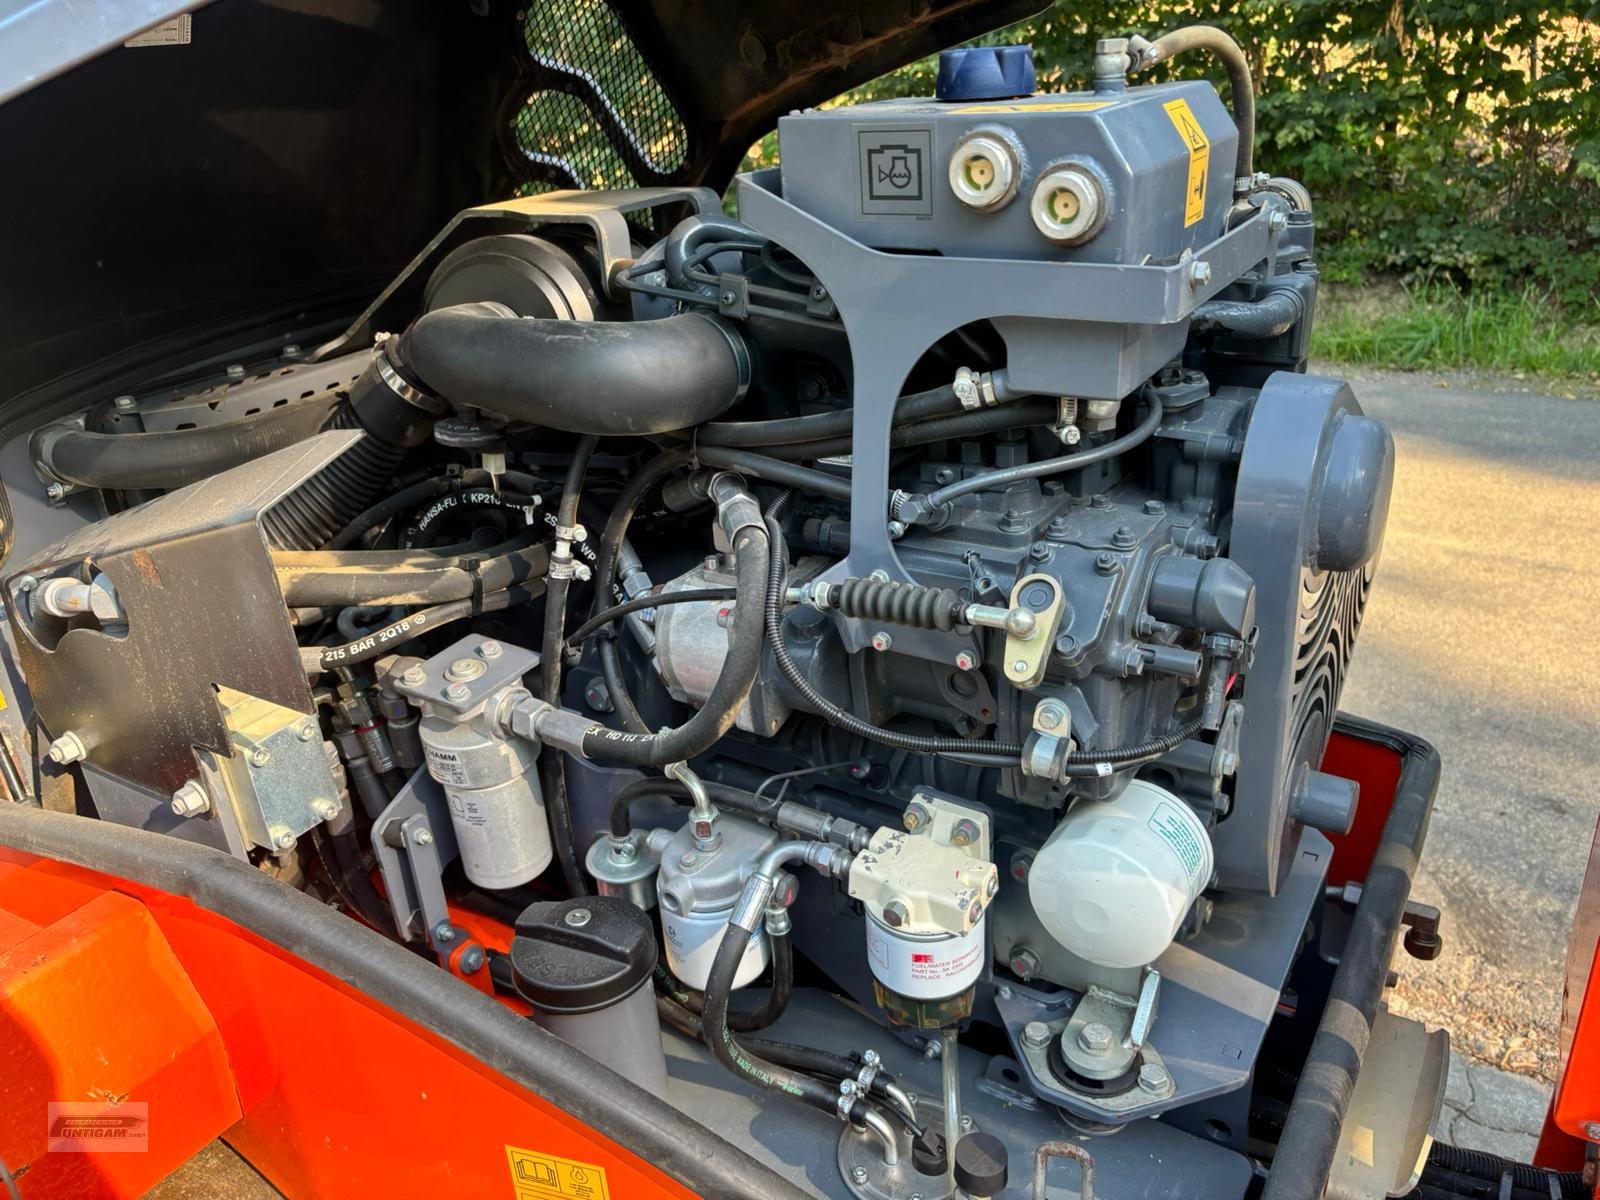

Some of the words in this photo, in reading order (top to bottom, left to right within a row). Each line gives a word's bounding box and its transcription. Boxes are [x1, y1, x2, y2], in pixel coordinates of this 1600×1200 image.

[325, 648, 346, 662] 215
[350, 637, 376, 655] BAR
[379, 621, 411, 643] 2Q18
[429, 749, 457, 762] HAMM
